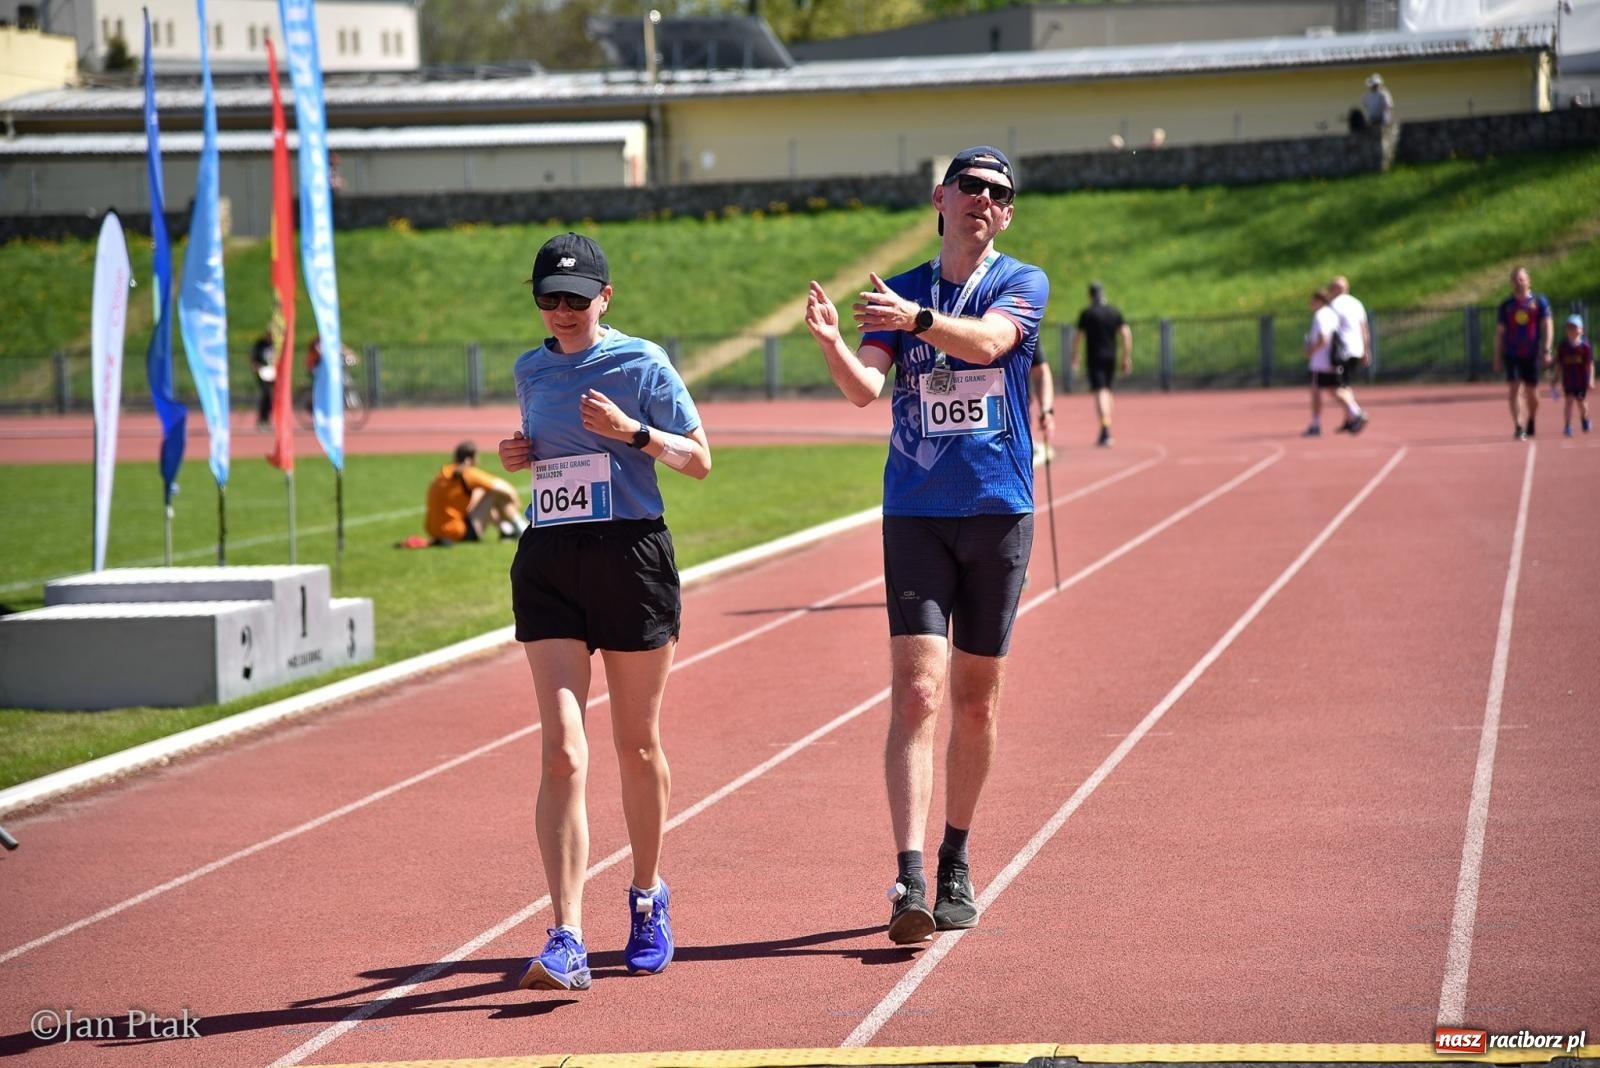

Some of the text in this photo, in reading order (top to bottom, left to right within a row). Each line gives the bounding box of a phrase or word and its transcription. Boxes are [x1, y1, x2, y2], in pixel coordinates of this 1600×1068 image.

[557, 257, 577, 268] NB
[964, 375, 986, 383] GRANIC
[931, 398, 984, 426] 065
[547, 463, 559, 471] BIEG
[560, 461, 569, 469] BEZ
[569, 459, 591, 468] GRANIC
[540, 485, 589, 514] 064
[300, 584, 308, 639] 1
[346, 617, 357, 659] 3
[240, 625, 253, 680] 2
